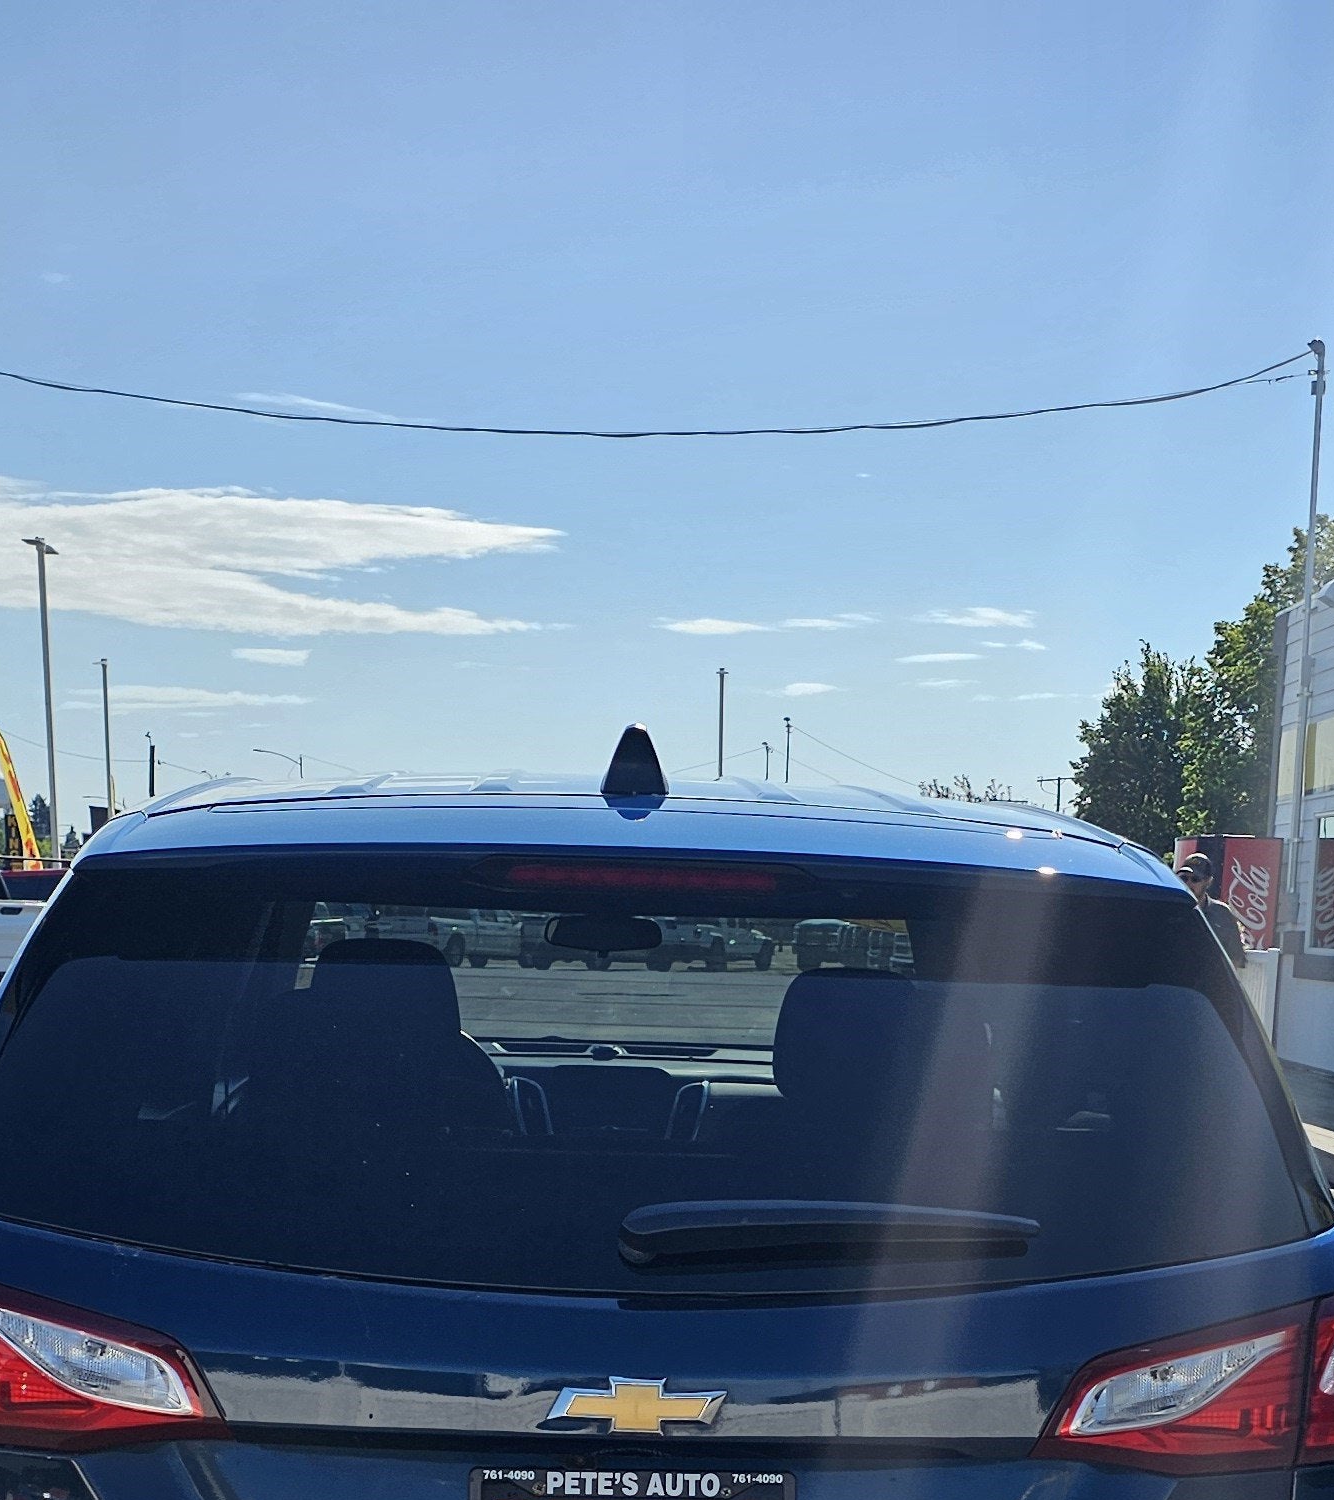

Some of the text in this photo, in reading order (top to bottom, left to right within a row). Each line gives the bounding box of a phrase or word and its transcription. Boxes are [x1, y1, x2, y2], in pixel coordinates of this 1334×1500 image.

[1229, 857, 1271, 931] Cola
[482, 1470, 535, 1481] 761-4090
[546, 1471, 721, 1497] PETE'S AUTO
[731, 1473, 784, 1485] 761-4090
